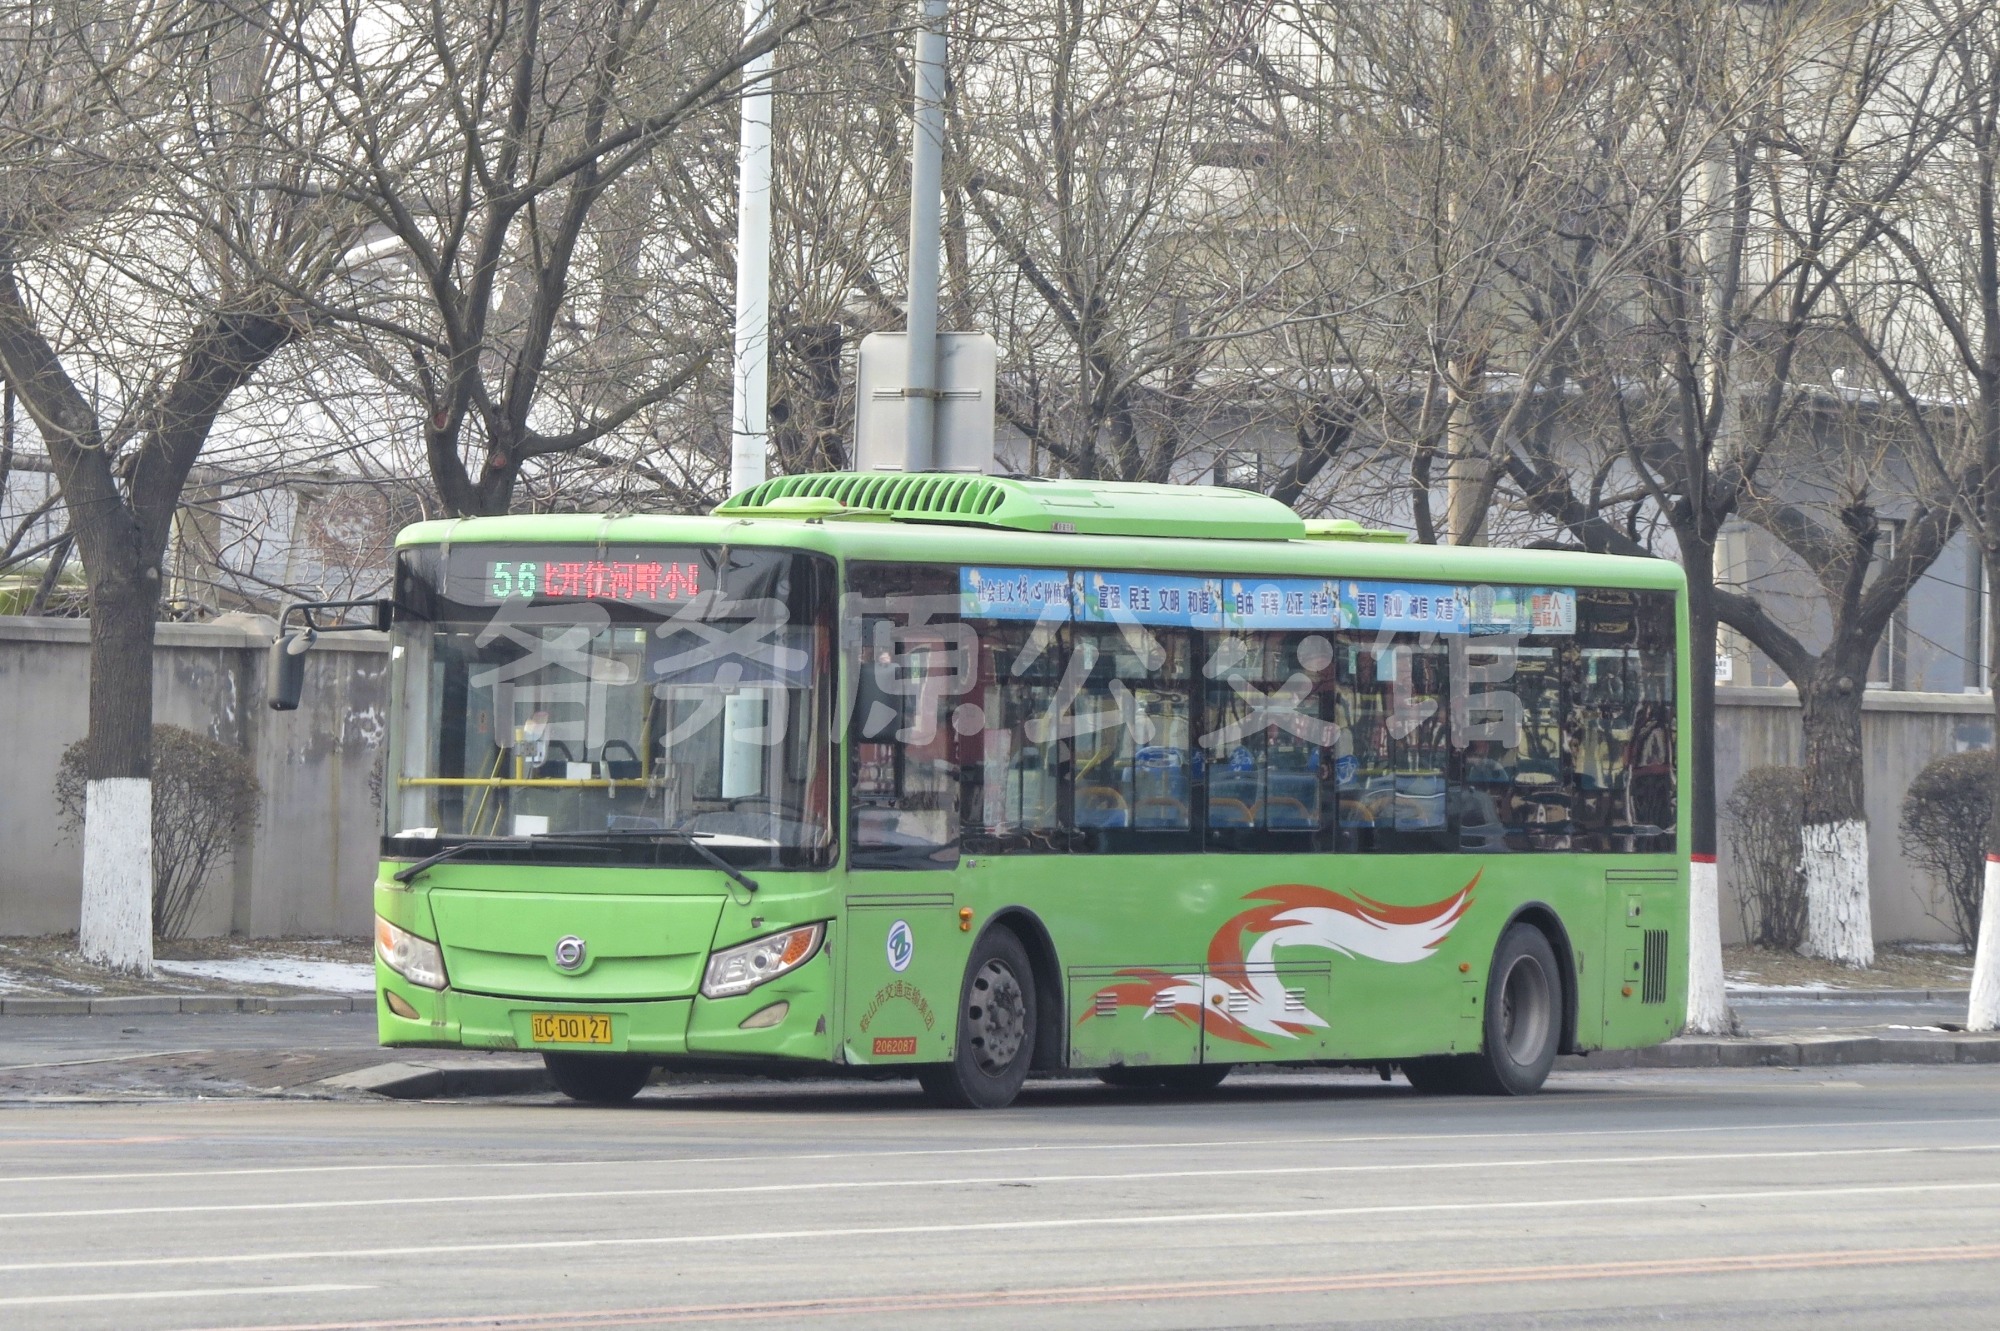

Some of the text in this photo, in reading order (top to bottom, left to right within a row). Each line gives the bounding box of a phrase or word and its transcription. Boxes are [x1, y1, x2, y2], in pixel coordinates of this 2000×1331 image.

[492, 561, 537, 598] 56
[1098, 584, 1210, 614] 富强 民主 文明 和谐
[1236, 592, 1328, 616] 自由 平等 公正 法治
[1357, 594, 1454, 620] 爱国 敬业 诚信 友善
[875, 1039, 915, 1053] 2062087
